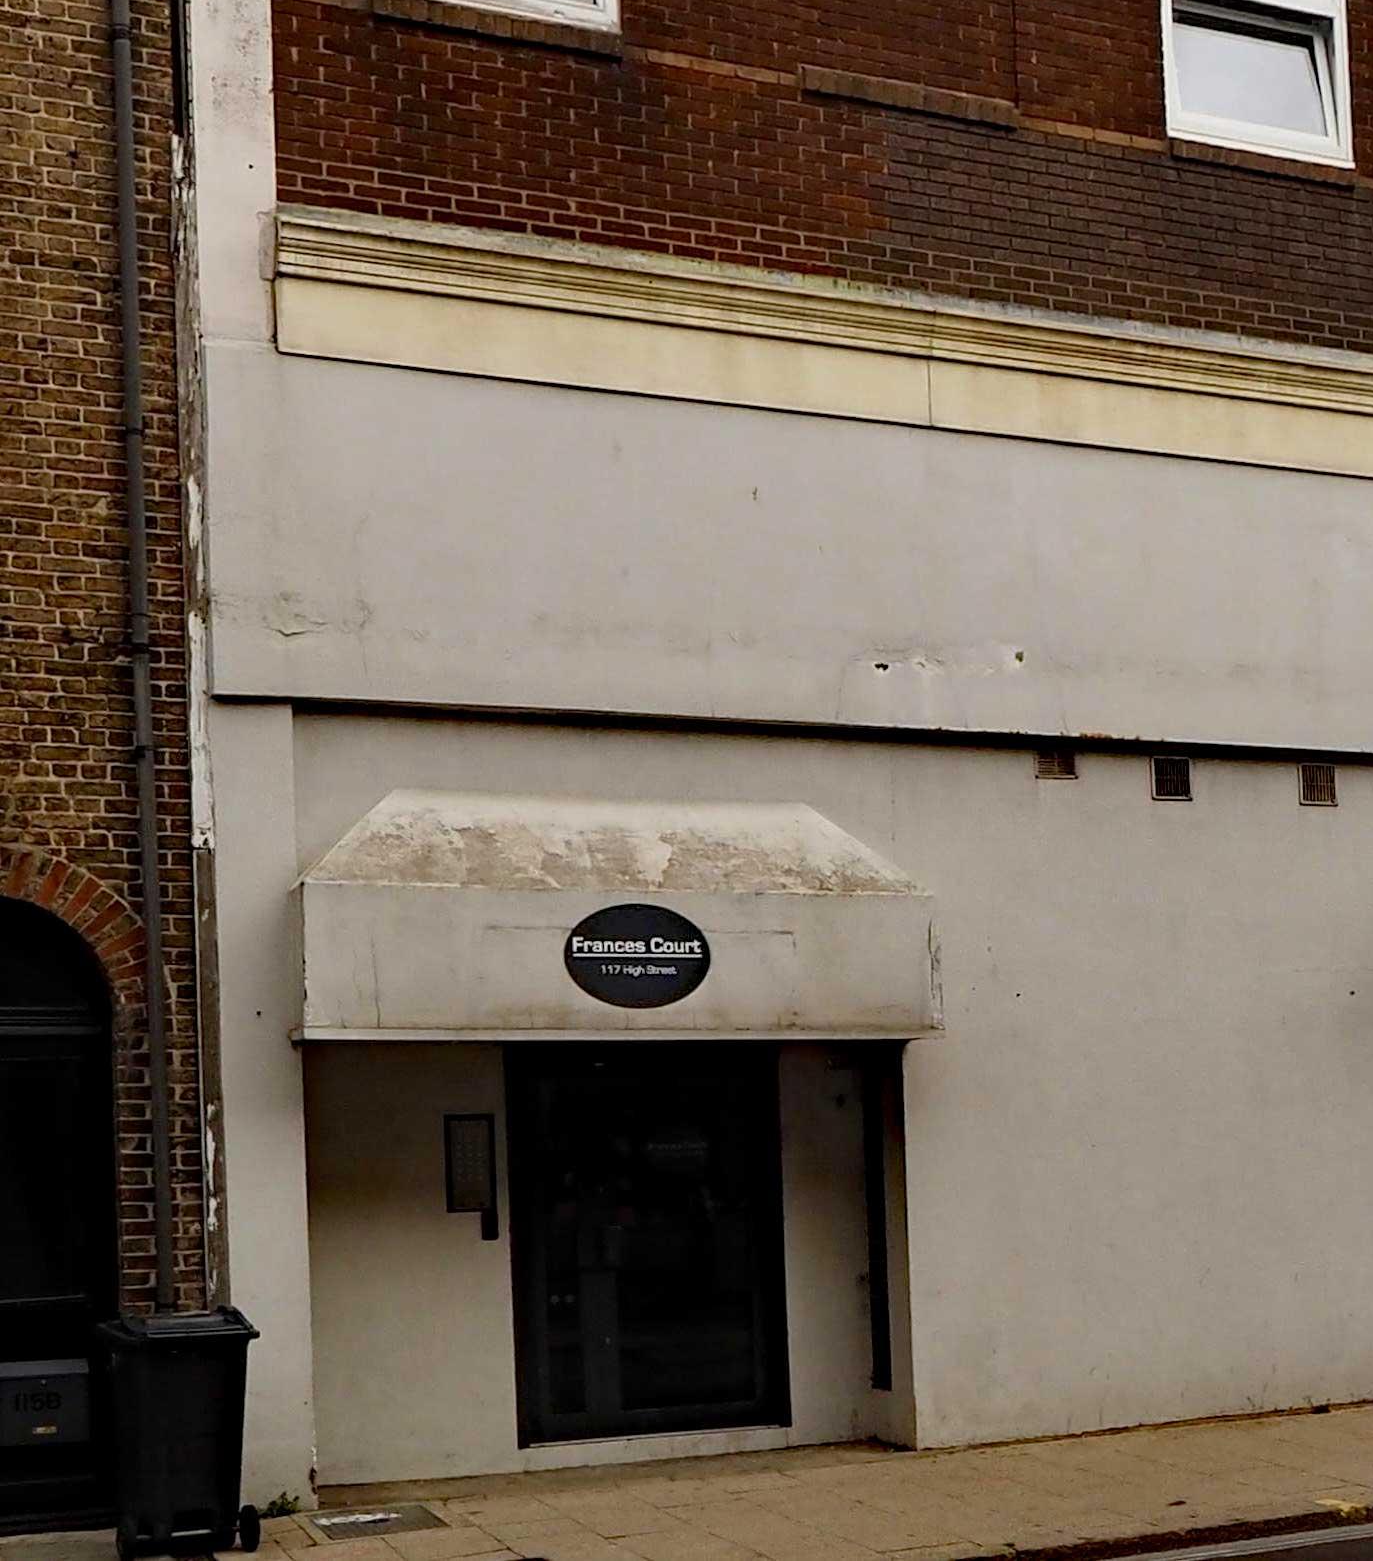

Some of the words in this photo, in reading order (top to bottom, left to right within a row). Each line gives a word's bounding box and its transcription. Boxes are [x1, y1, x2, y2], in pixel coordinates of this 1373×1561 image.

[572, 937, 646, 953] Frances
[650, 937, 702, 953] Court
[601, 964, 621, 975] 117
[623, 964, 645, 977] High
